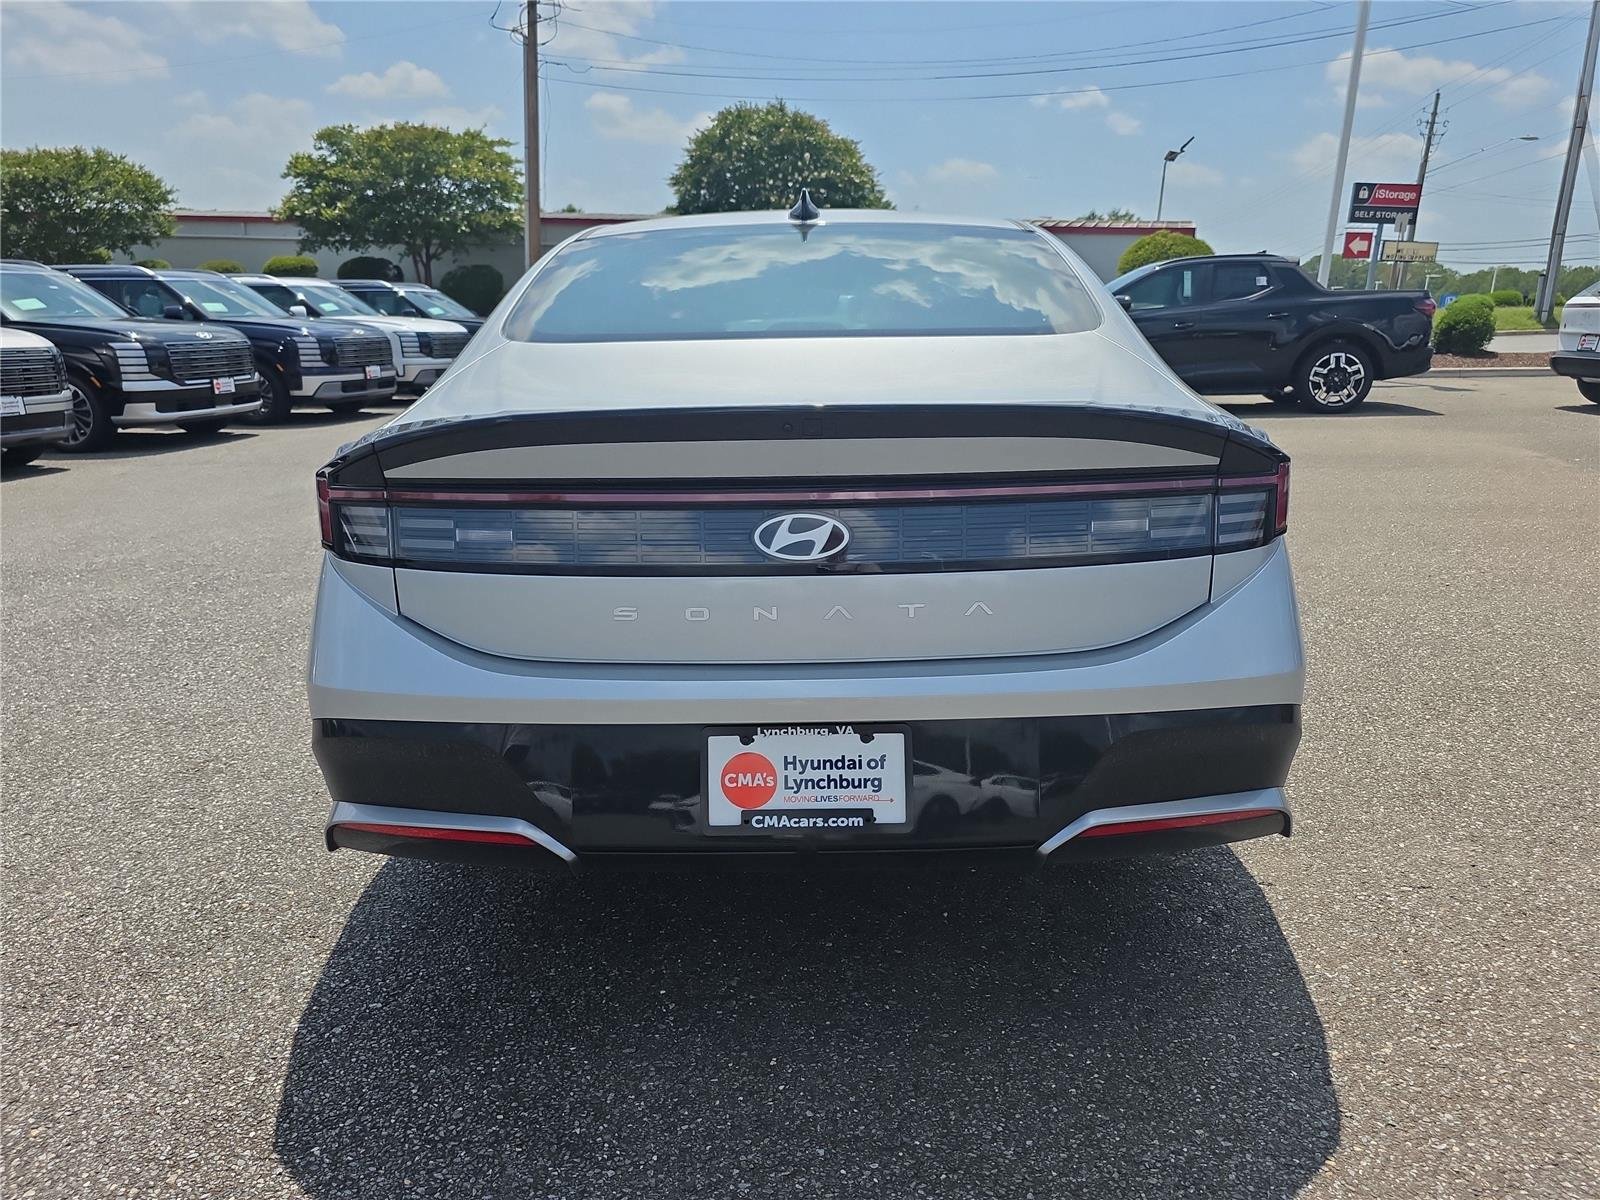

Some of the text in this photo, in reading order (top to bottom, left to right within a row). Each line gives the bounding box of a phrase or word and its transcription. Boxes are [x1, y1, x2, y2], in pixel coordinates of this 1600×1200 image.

[1376, 190, 1416, 201] iStorage
[613, 601, 993, 621] SONATA
[757, 726, 854, 736] Lynchburg, VA
[783, 754, 886, 774] Hyundai of
[724, 772, 775, 788] CMA's
[783, 774, 883, 794] Lynchburg
[751, 815, 864, 828] CMAcars.com
